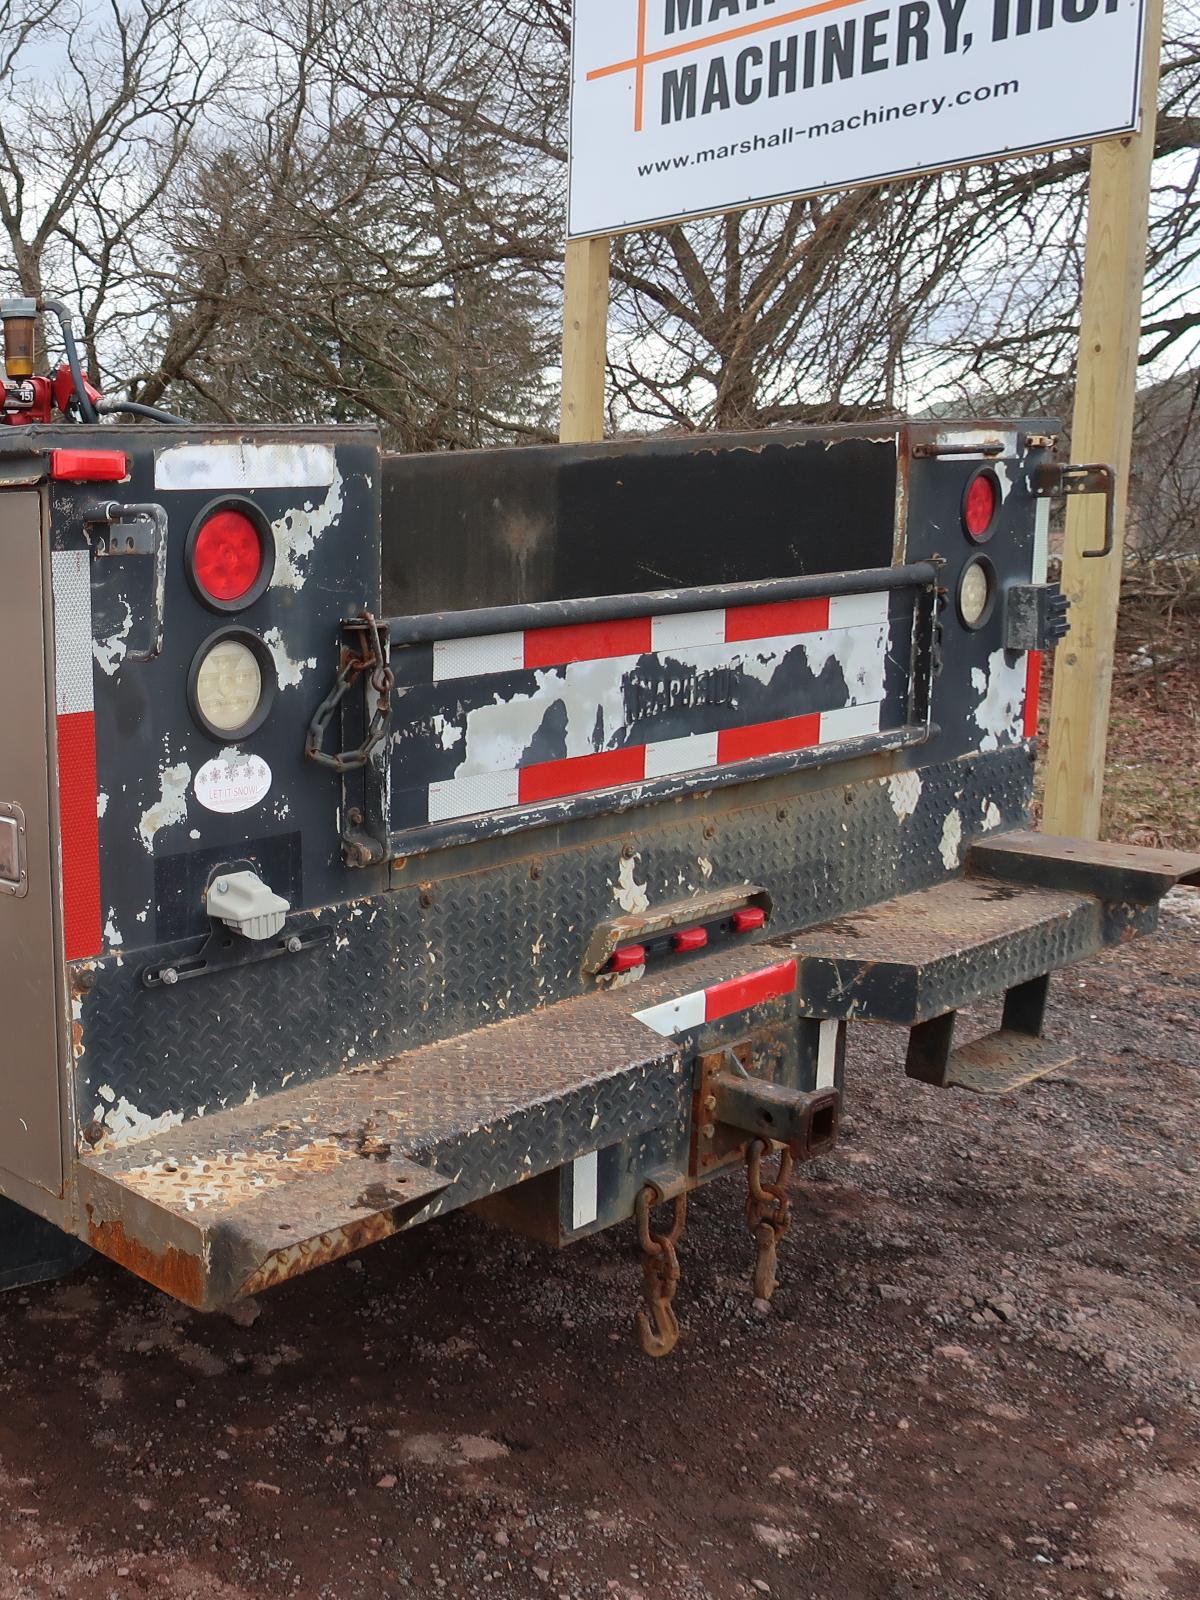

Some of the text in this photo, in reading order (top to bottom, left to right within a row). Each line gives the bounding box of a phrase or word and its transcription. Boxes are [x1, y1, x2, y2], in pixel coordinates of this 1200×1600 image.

[661, 0, 973, 125] MACHINERY,
[637, 79, 1020, 177] www.marshall-machinery.com
[209, 788, 222, 800] LET
[223, 787, 231, 798] IT
